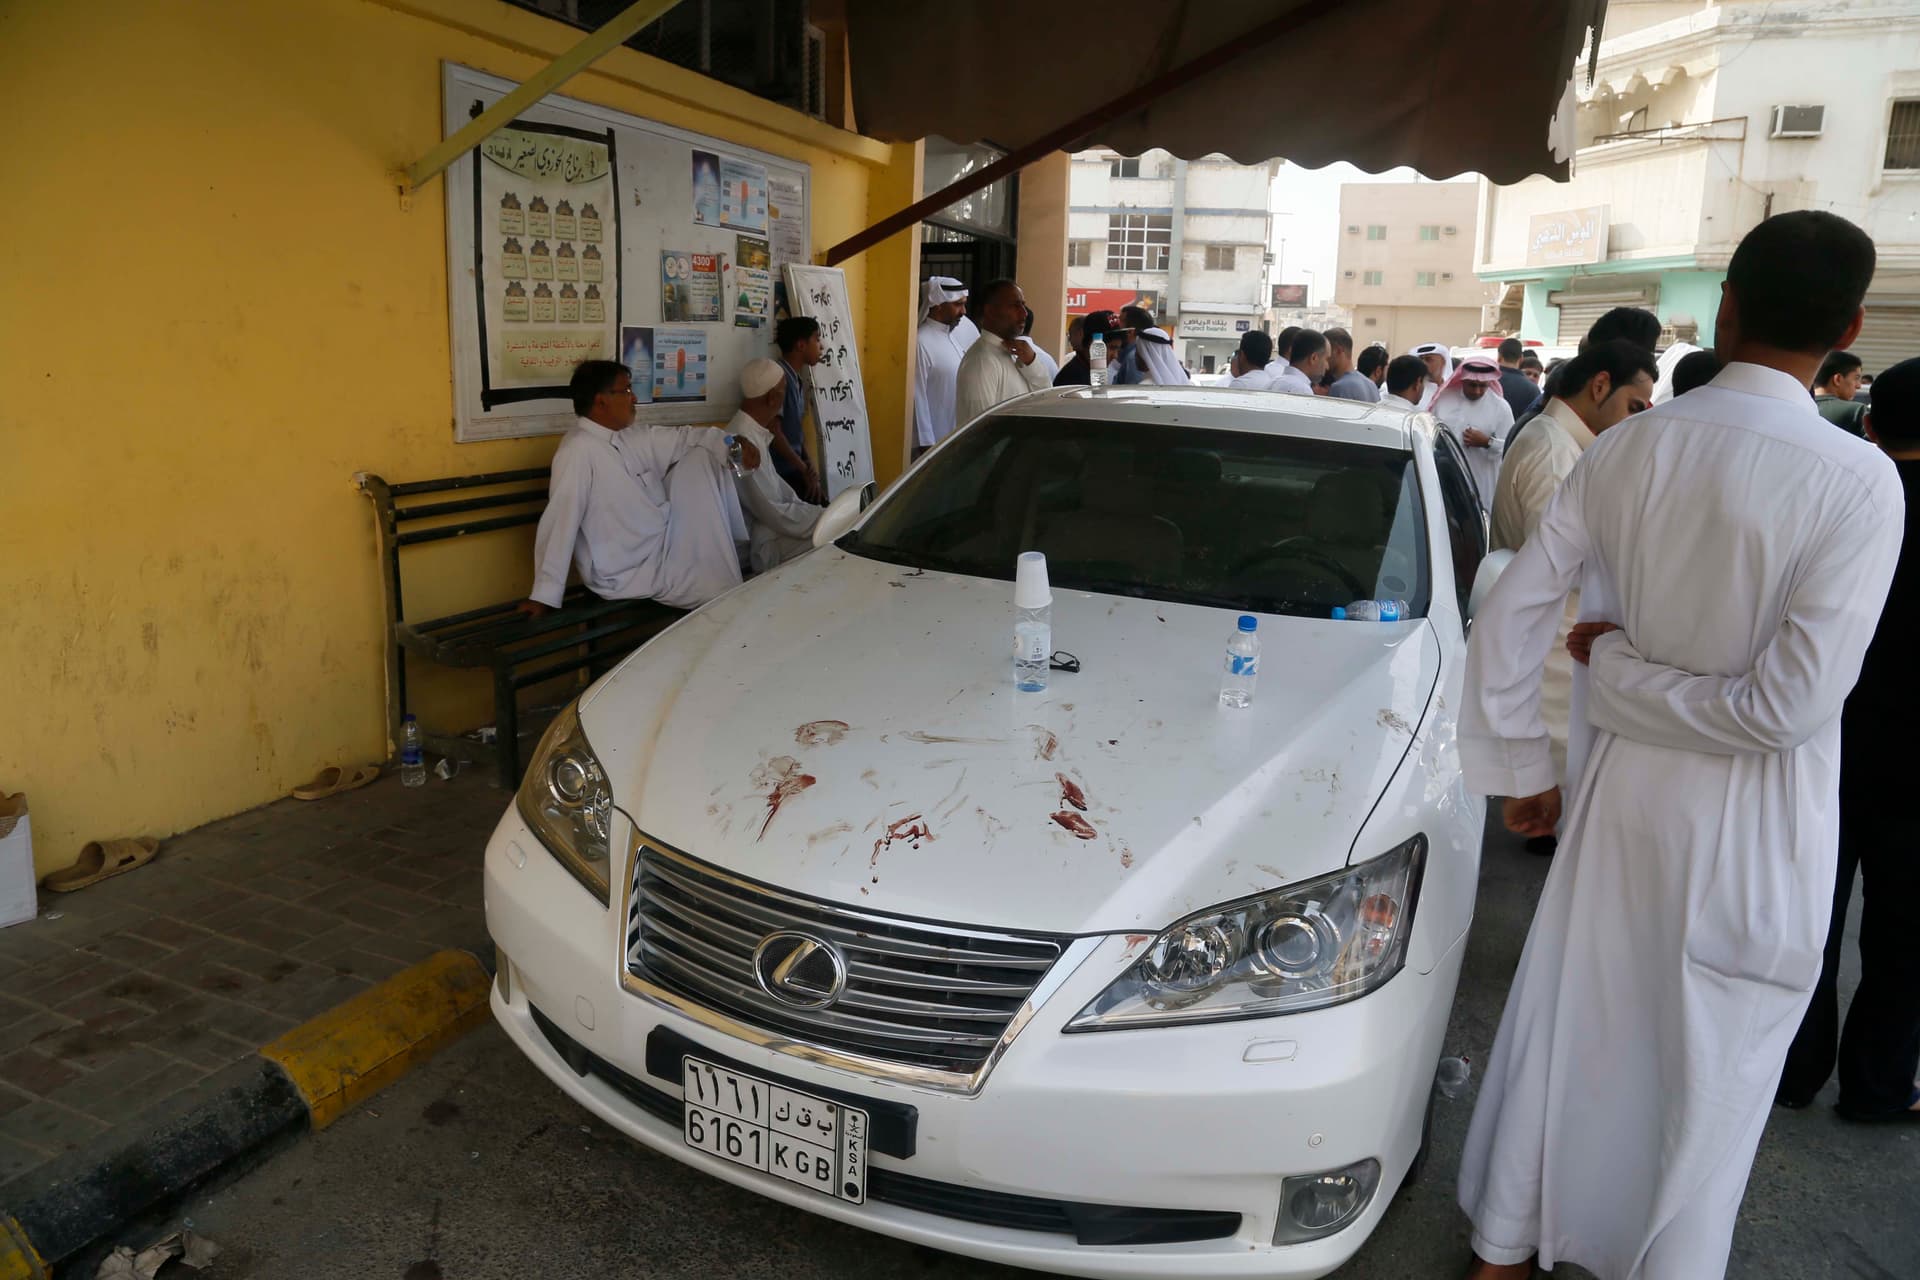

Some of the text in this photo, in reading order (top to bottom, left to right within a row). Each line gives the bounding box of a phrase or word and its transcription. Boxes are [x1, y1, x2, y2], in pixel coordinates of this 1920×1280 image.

[692, 255, 711, 266] 4300
[688, 1063, 759, 1119] ٦١٦١
[688, 1110, 761, 1165] 6161
[775, 1143, 830, 1181] KGB
[848, 1139, 858, 1176] KSA
